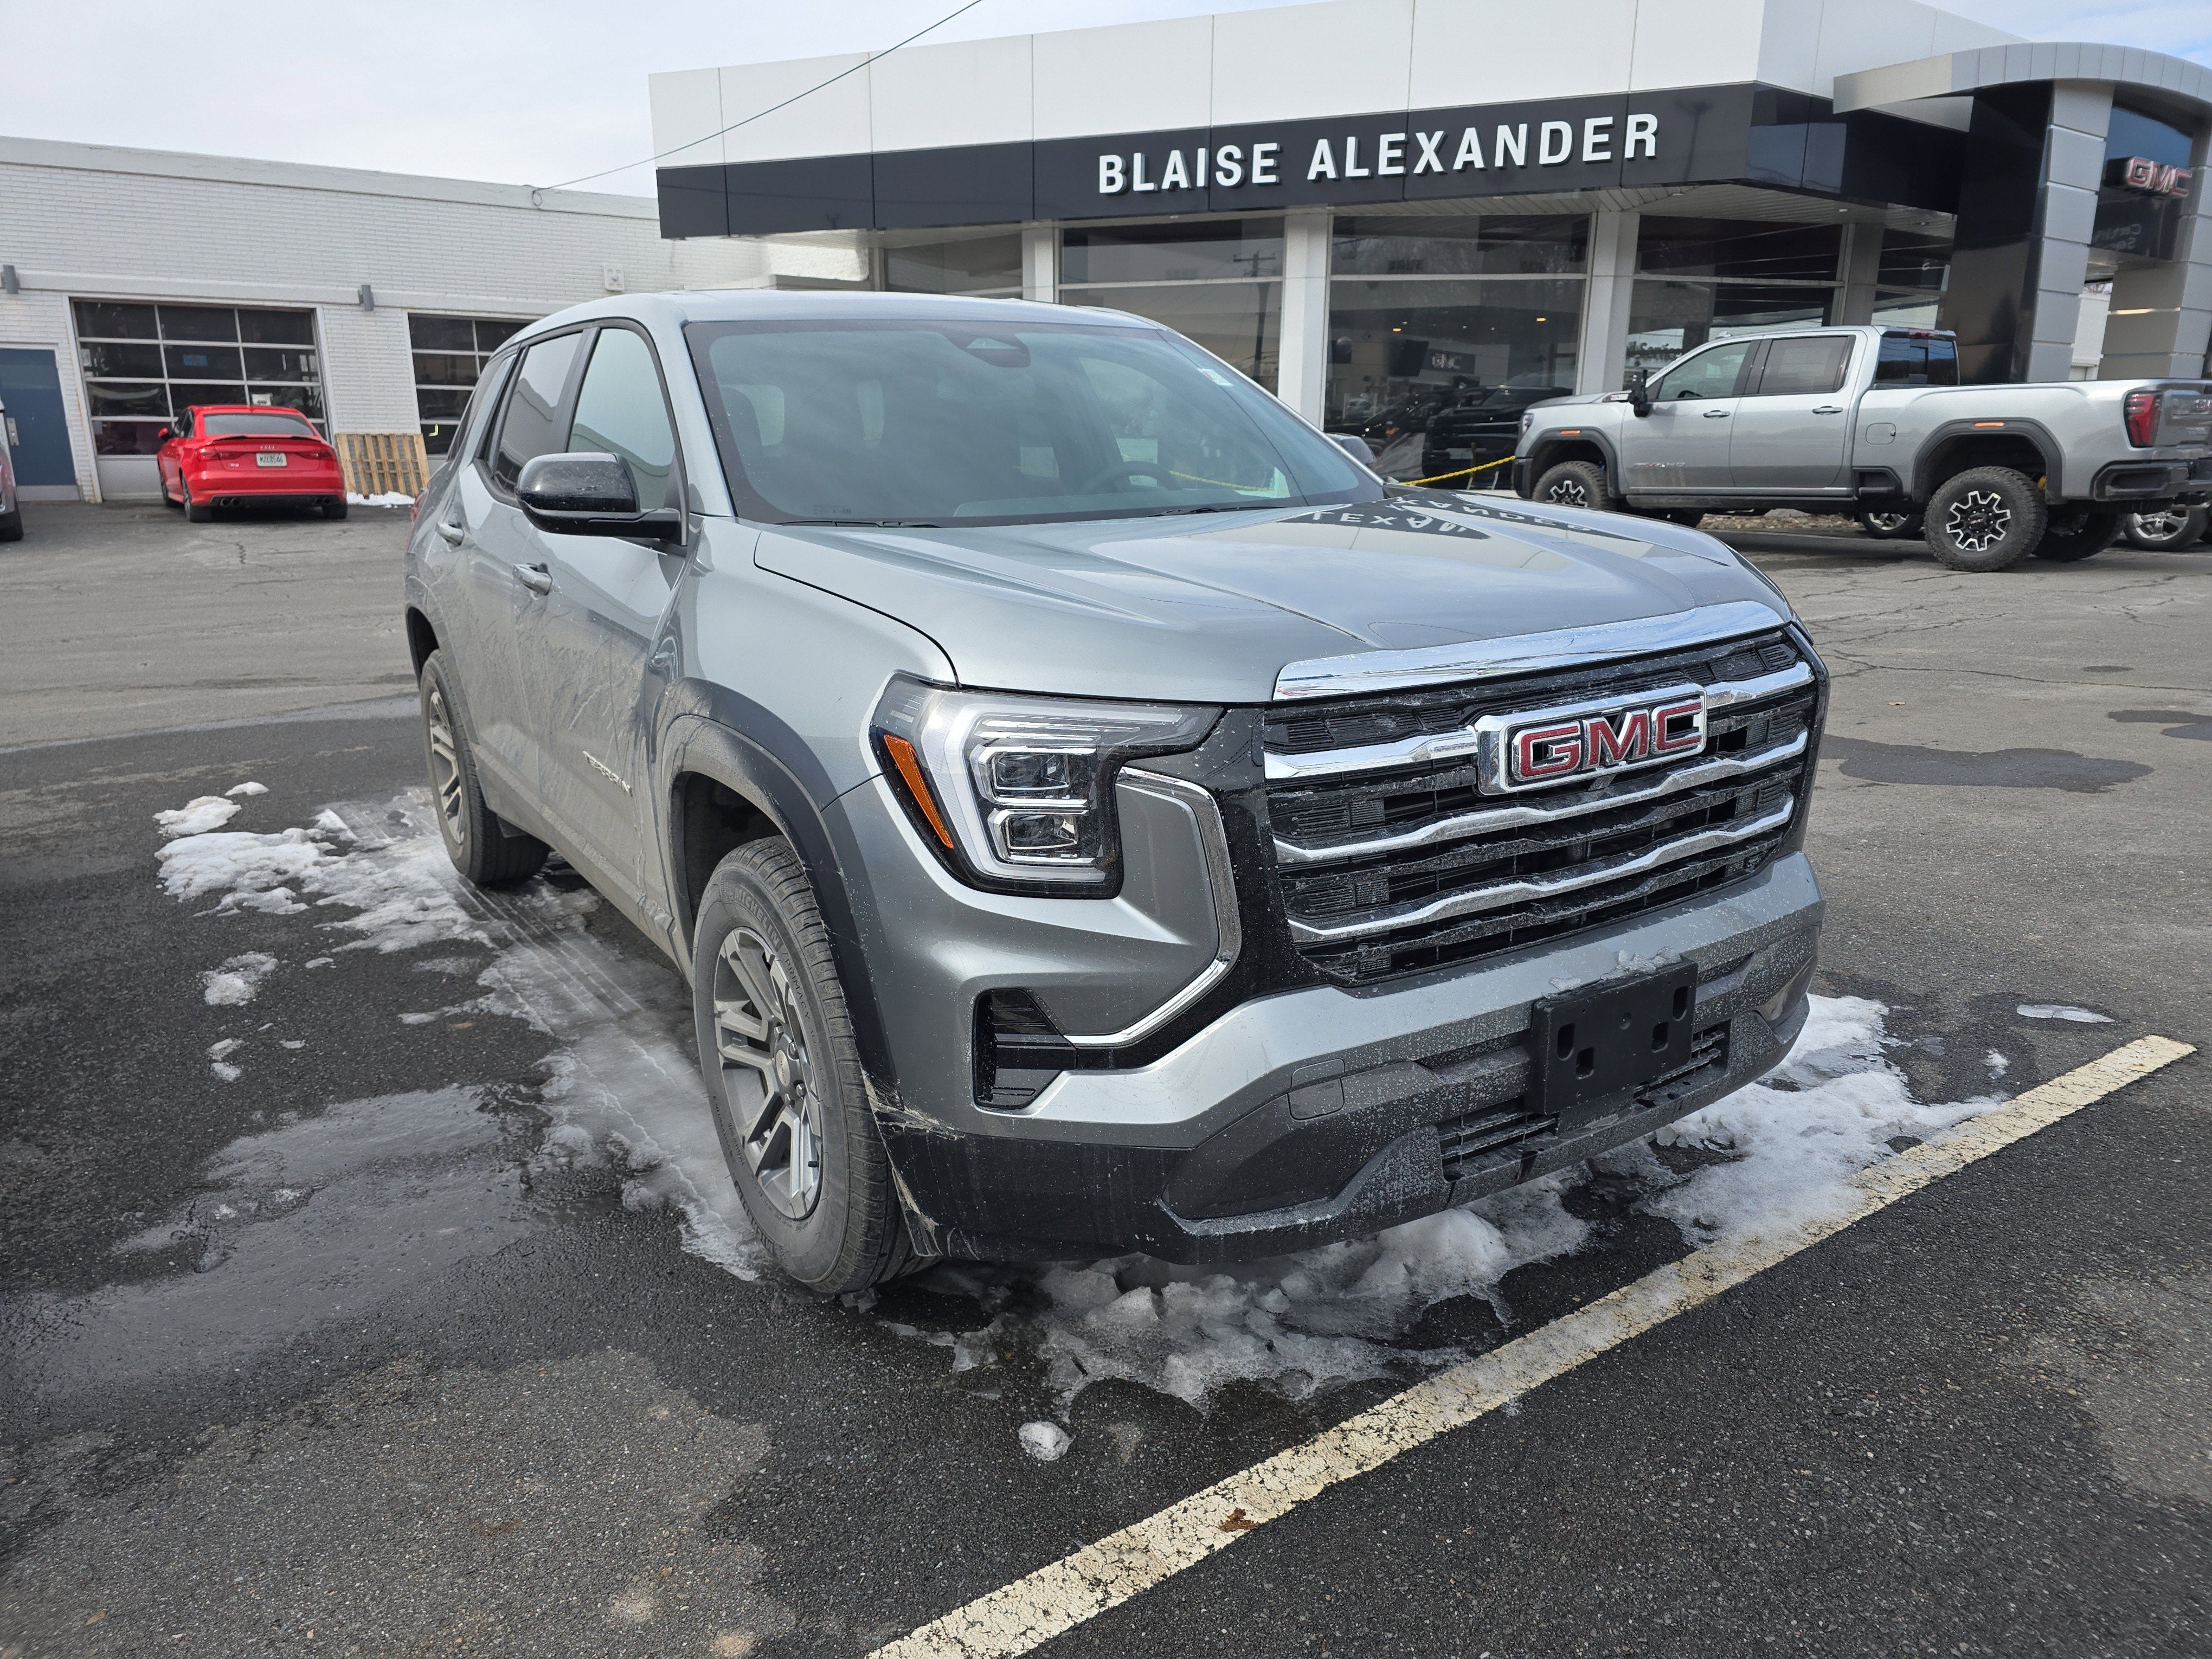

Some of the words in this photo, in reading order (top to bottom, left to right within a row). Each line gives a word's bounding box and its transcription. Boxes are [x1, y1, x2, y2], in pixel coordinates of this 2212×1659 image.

[1098, 142, 1280, 194] BLAISE
[1307, 113, 1660, 181] ALEXANDER
[2126, 156, 2192, 197] GMC
[1512, 699, 1703, 780] GMC
[734, 887, 780, 944] MICHELIN
[785, 959, 811, 1020] PRIMACY
